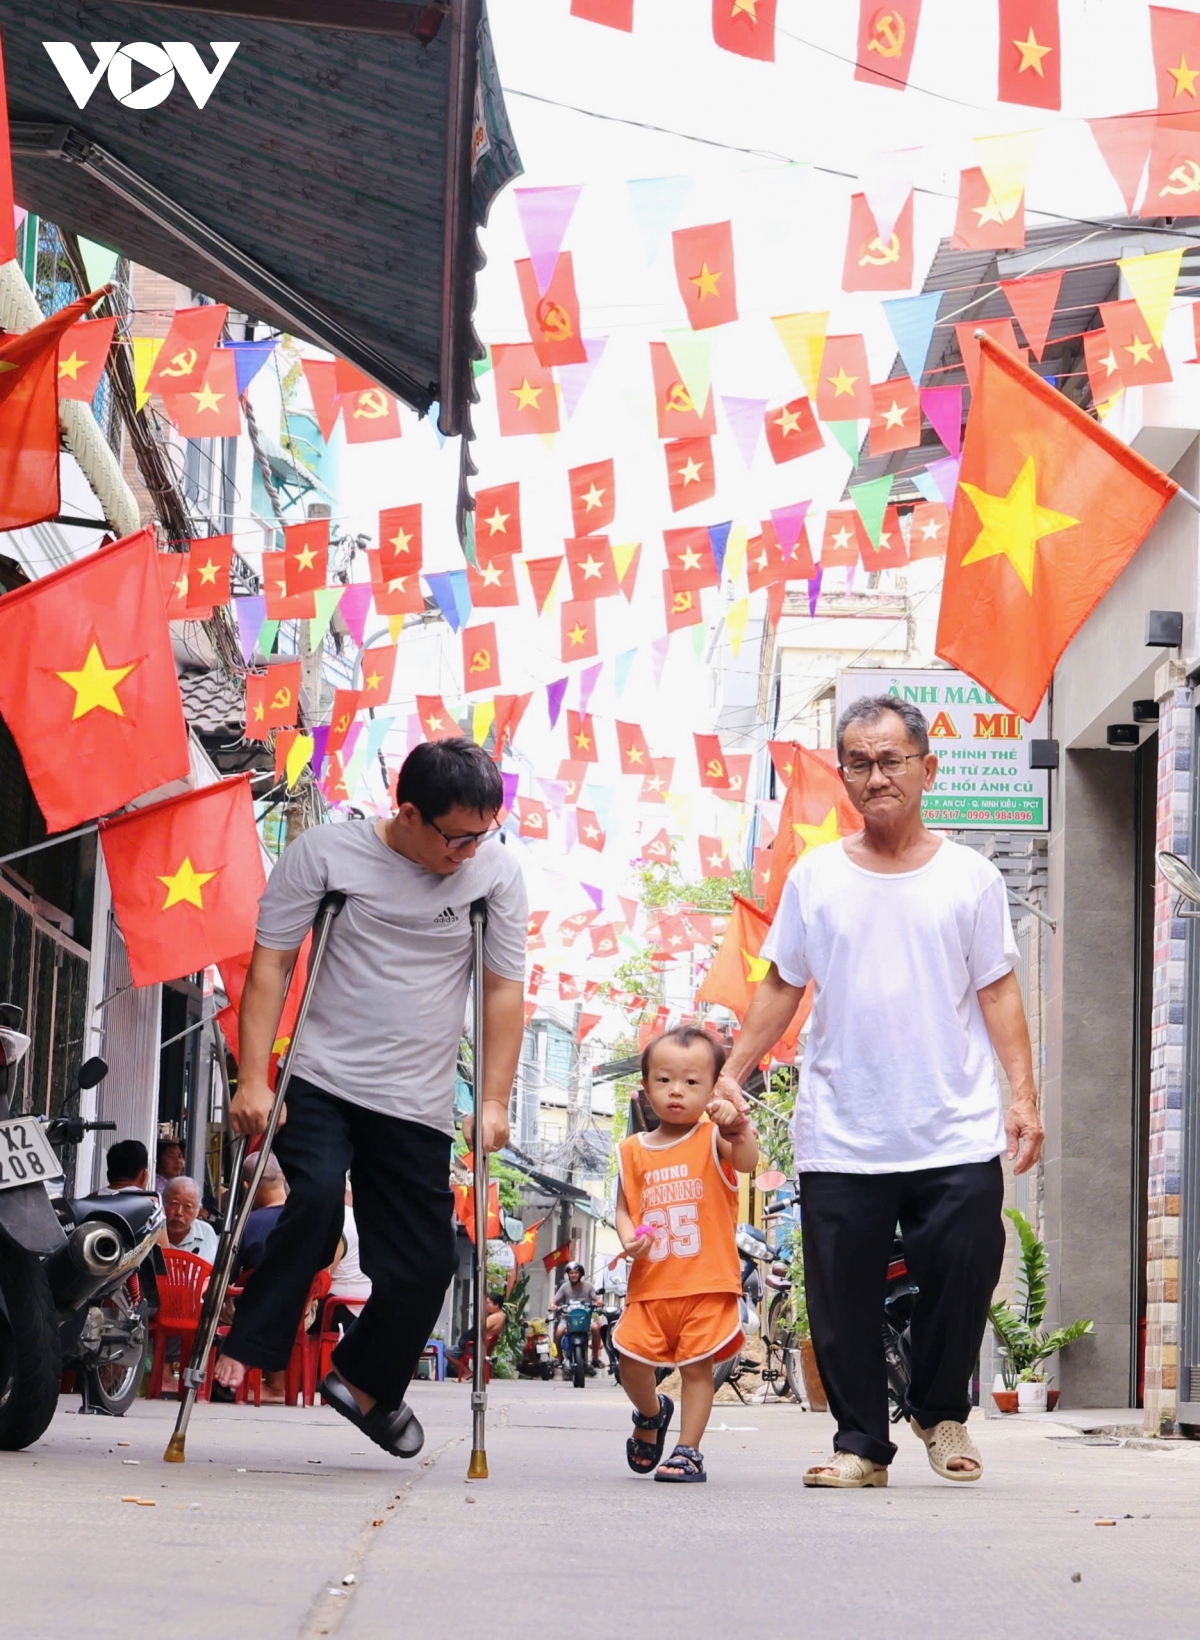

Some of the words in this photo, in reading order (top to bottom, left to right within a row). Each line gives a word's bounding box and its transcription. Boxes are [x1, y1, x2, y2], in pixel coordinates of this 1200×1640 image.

[973, 712, 1023, 740] MI
[981, 767, 1018, 776] ZALO
[980, 780, 1010, 792] ẢNH
[981, 800, 999, 808] NINH
[1023, 801, 1039, 809] TPCT
[923, 810, 940, 820] 767
[942, 810, 960, 820] 517
[994, 811, 1013, 821] 984
[1013, 811, 1033, 821] 896
[433, 915, 460, 924] adidas
[643, 1164, 689, 1186] YOUNG
[641, 1178, 704, 1213] WINNING
[642, 1202, 703, 1263] 65
